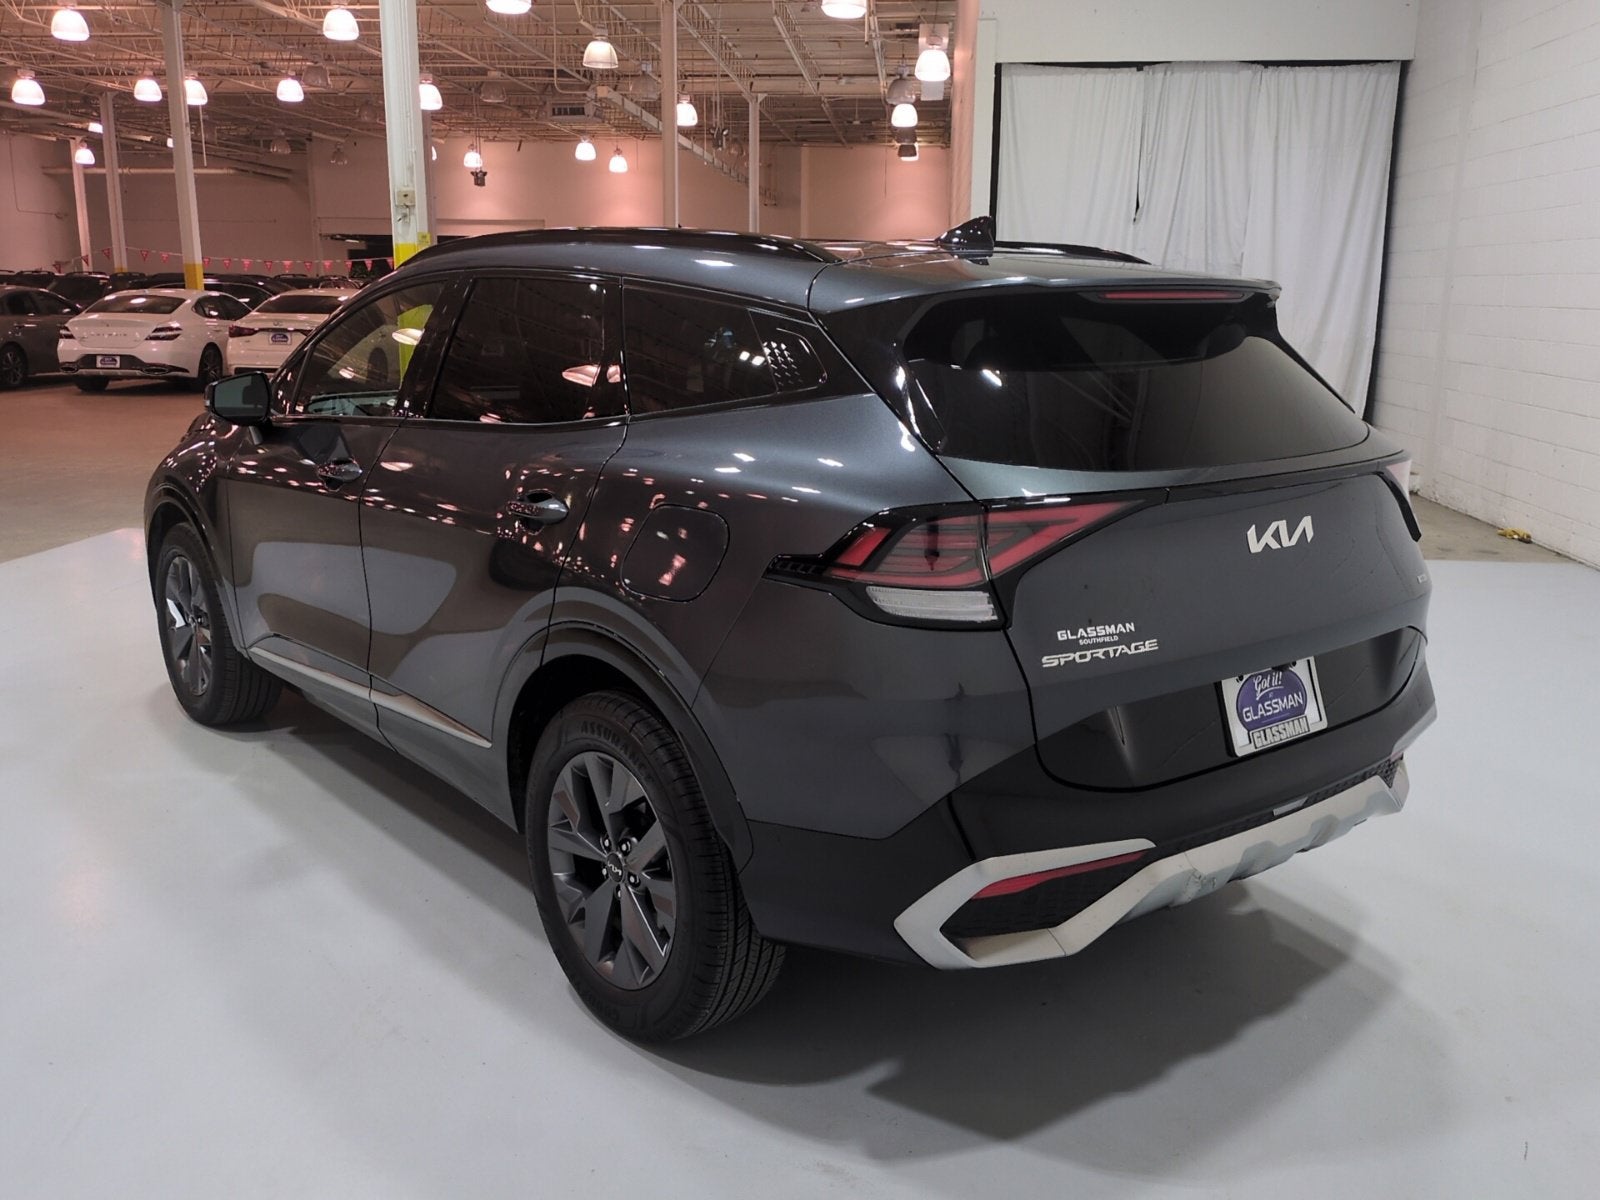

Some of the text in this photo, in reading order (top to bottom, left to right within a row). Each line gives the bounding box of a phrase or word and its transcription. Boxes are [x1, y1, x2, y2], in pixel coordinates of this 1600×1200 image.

[1247, 515, 1314, 554] KIA
[1057, 622, 1135, 641] GLASSMAN
[1079, 635, 1119, 645] SOUTHFIELD
[1041, 639, 1159, 668] SPORTAGE
[1253, 674, 1271, 698] Got
[1242, 692, 1304, 722] GLASSMAN
[1252, 717, 1309, 748] GLASSMAN
